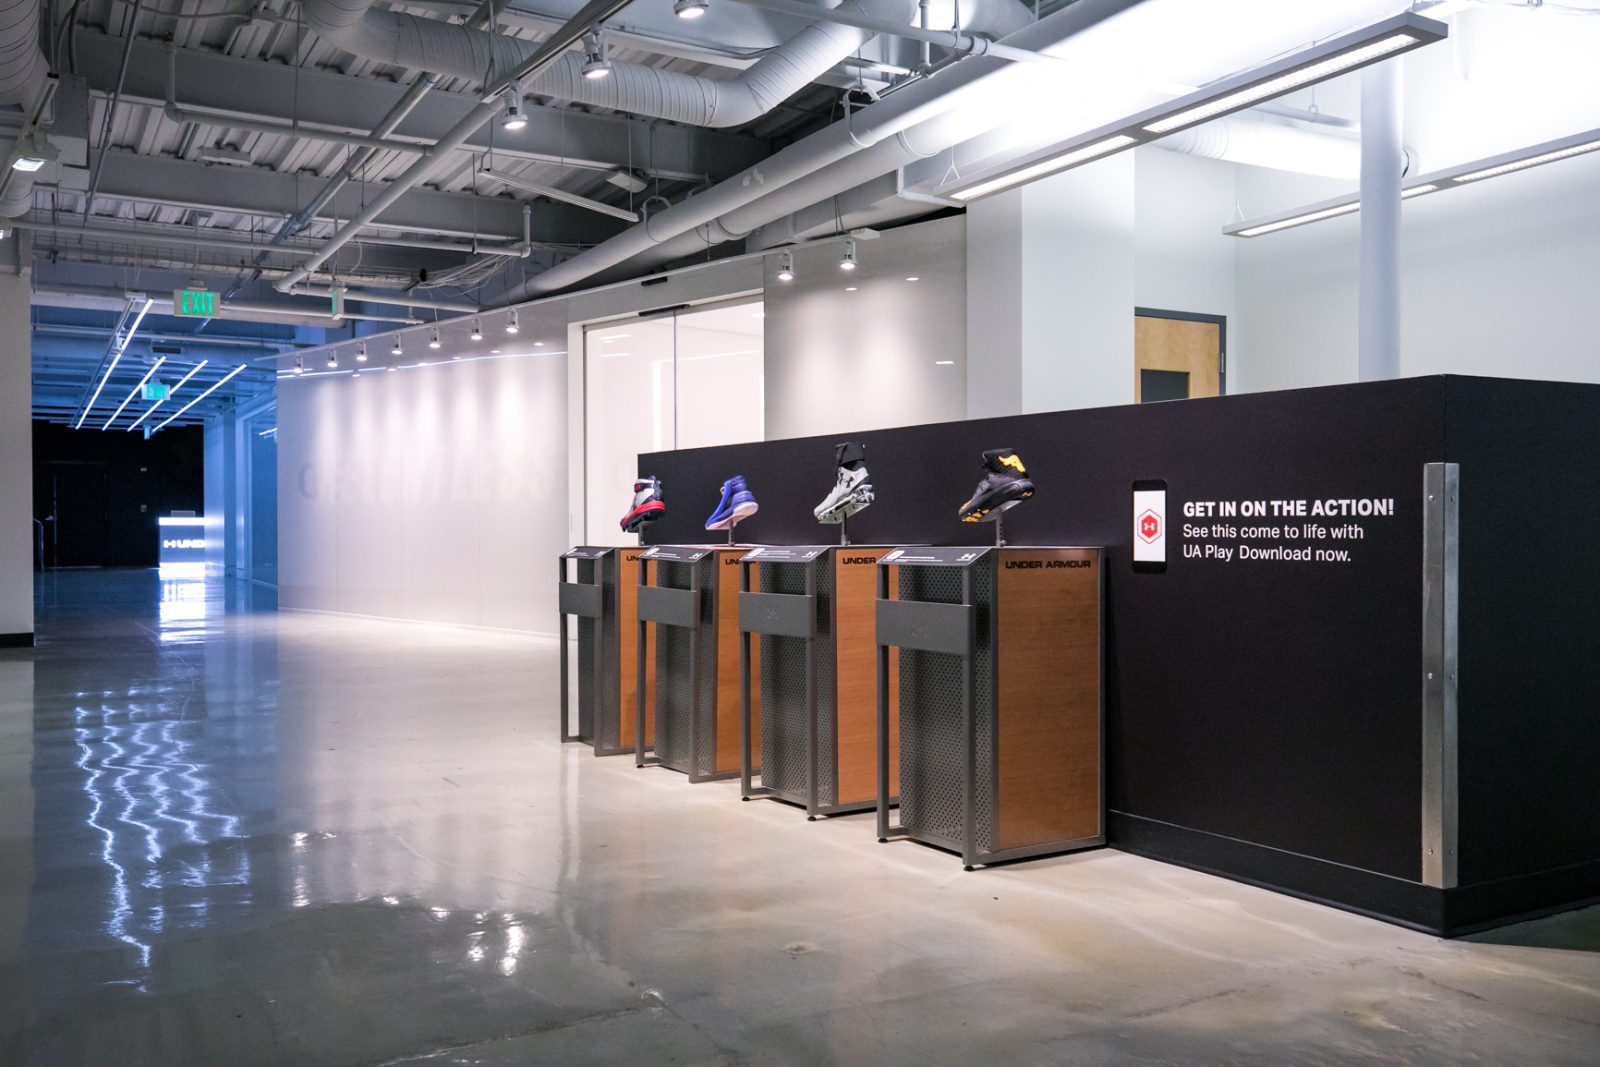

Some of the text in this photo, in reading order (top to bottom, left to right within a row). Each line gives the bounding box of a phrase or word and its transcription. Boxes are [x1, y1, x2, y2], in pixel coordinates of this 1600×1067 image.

[181, 291, 214, 315] EXIT
[147, 384, 166, 399] EXIT
[1183, 498, 1394, 517] GET IN ON THE ACTION!
[1183, 524, 1364, 539] See this come to life with
[842, 556, 876, 565] UNDER
[1183, 544, 1352, 562] UA Play Download now.
[1005, 560, 1091, 569] UNDER ARMOUR
